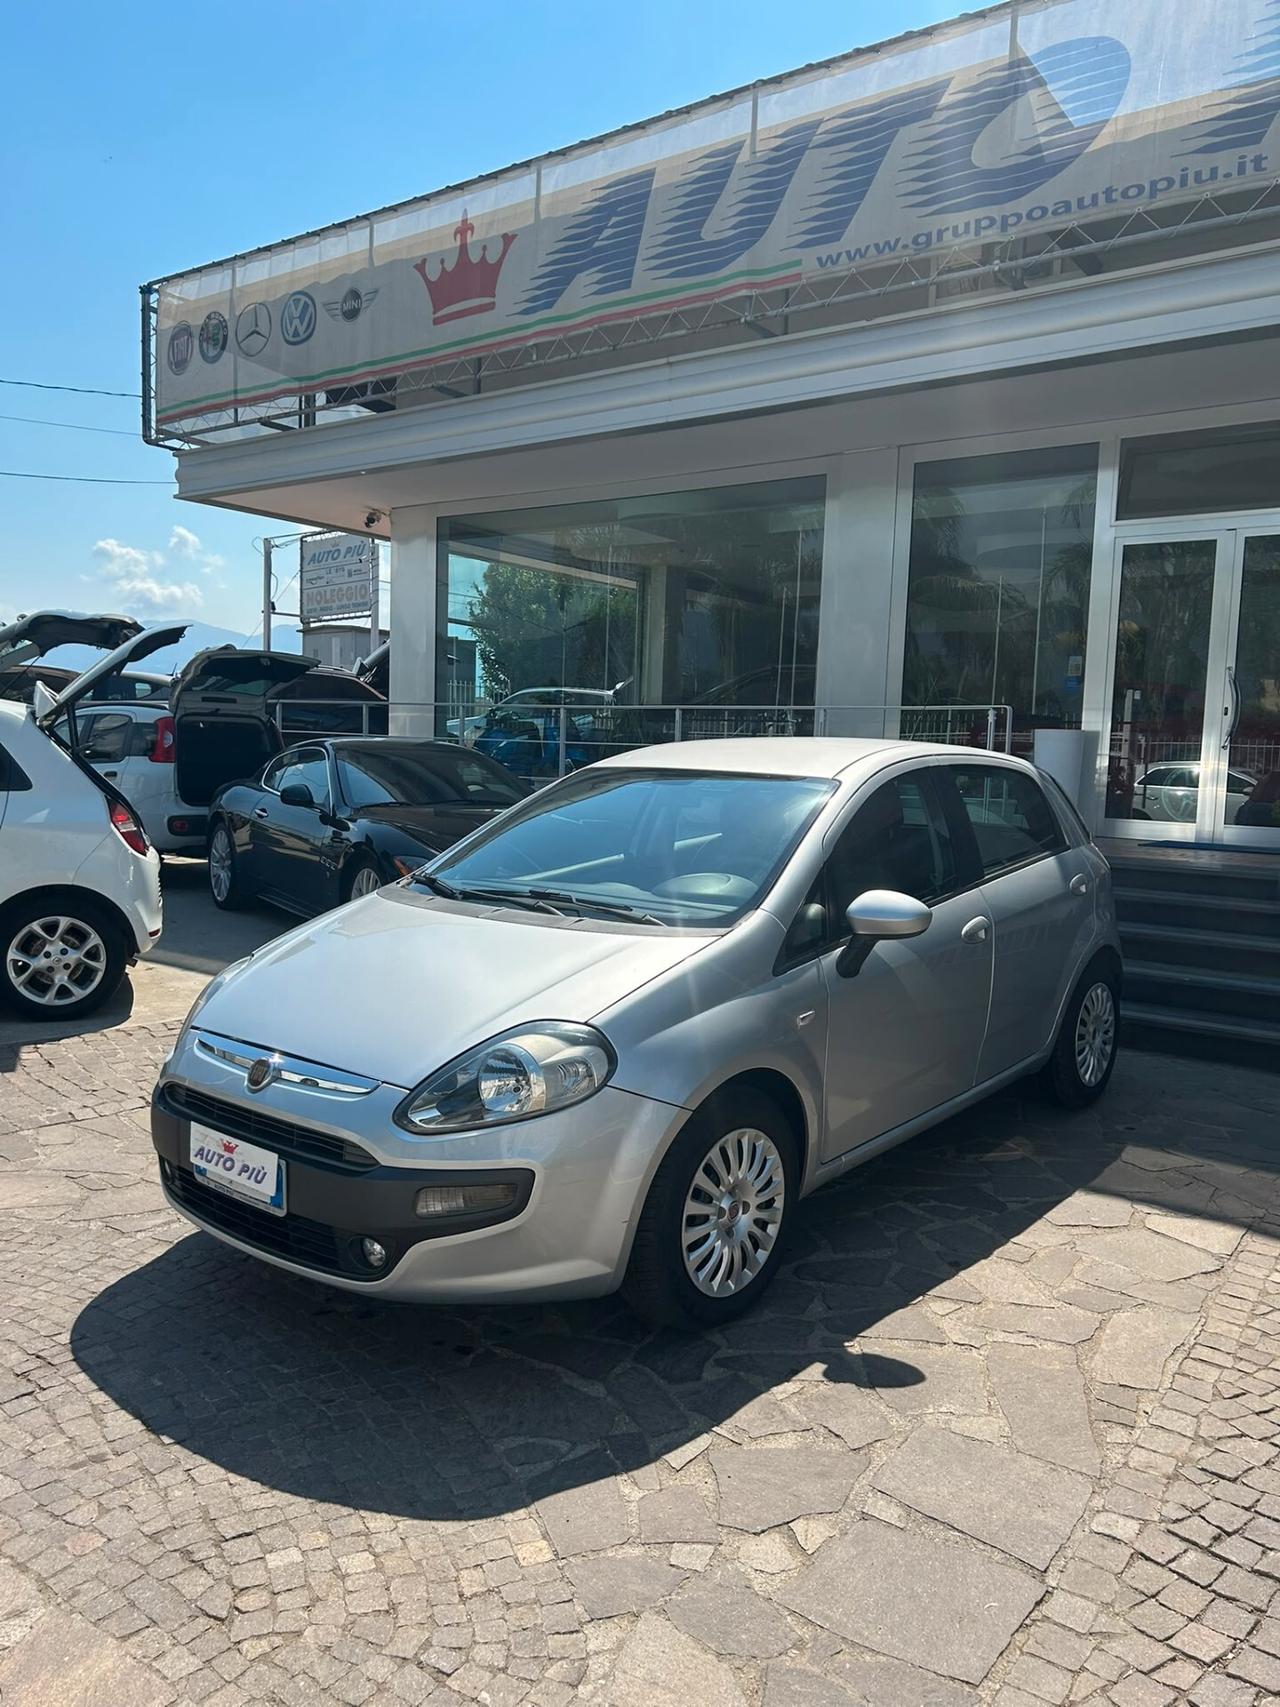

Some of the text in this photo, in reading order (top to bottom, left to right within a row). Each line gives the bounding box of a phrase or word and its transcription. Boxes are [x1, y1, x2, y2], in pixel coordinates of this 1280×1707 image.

[504, 35, 1132, 318] AUTO
[816, 152, 1269, 269] www.gruppoautopiu.it
[307, 540, 367, 566] AUTO PIÙ
[305, 583, 368, 607] NOLEGGIO
[194, 1145, 268, 1185] AUTO PIÙ
